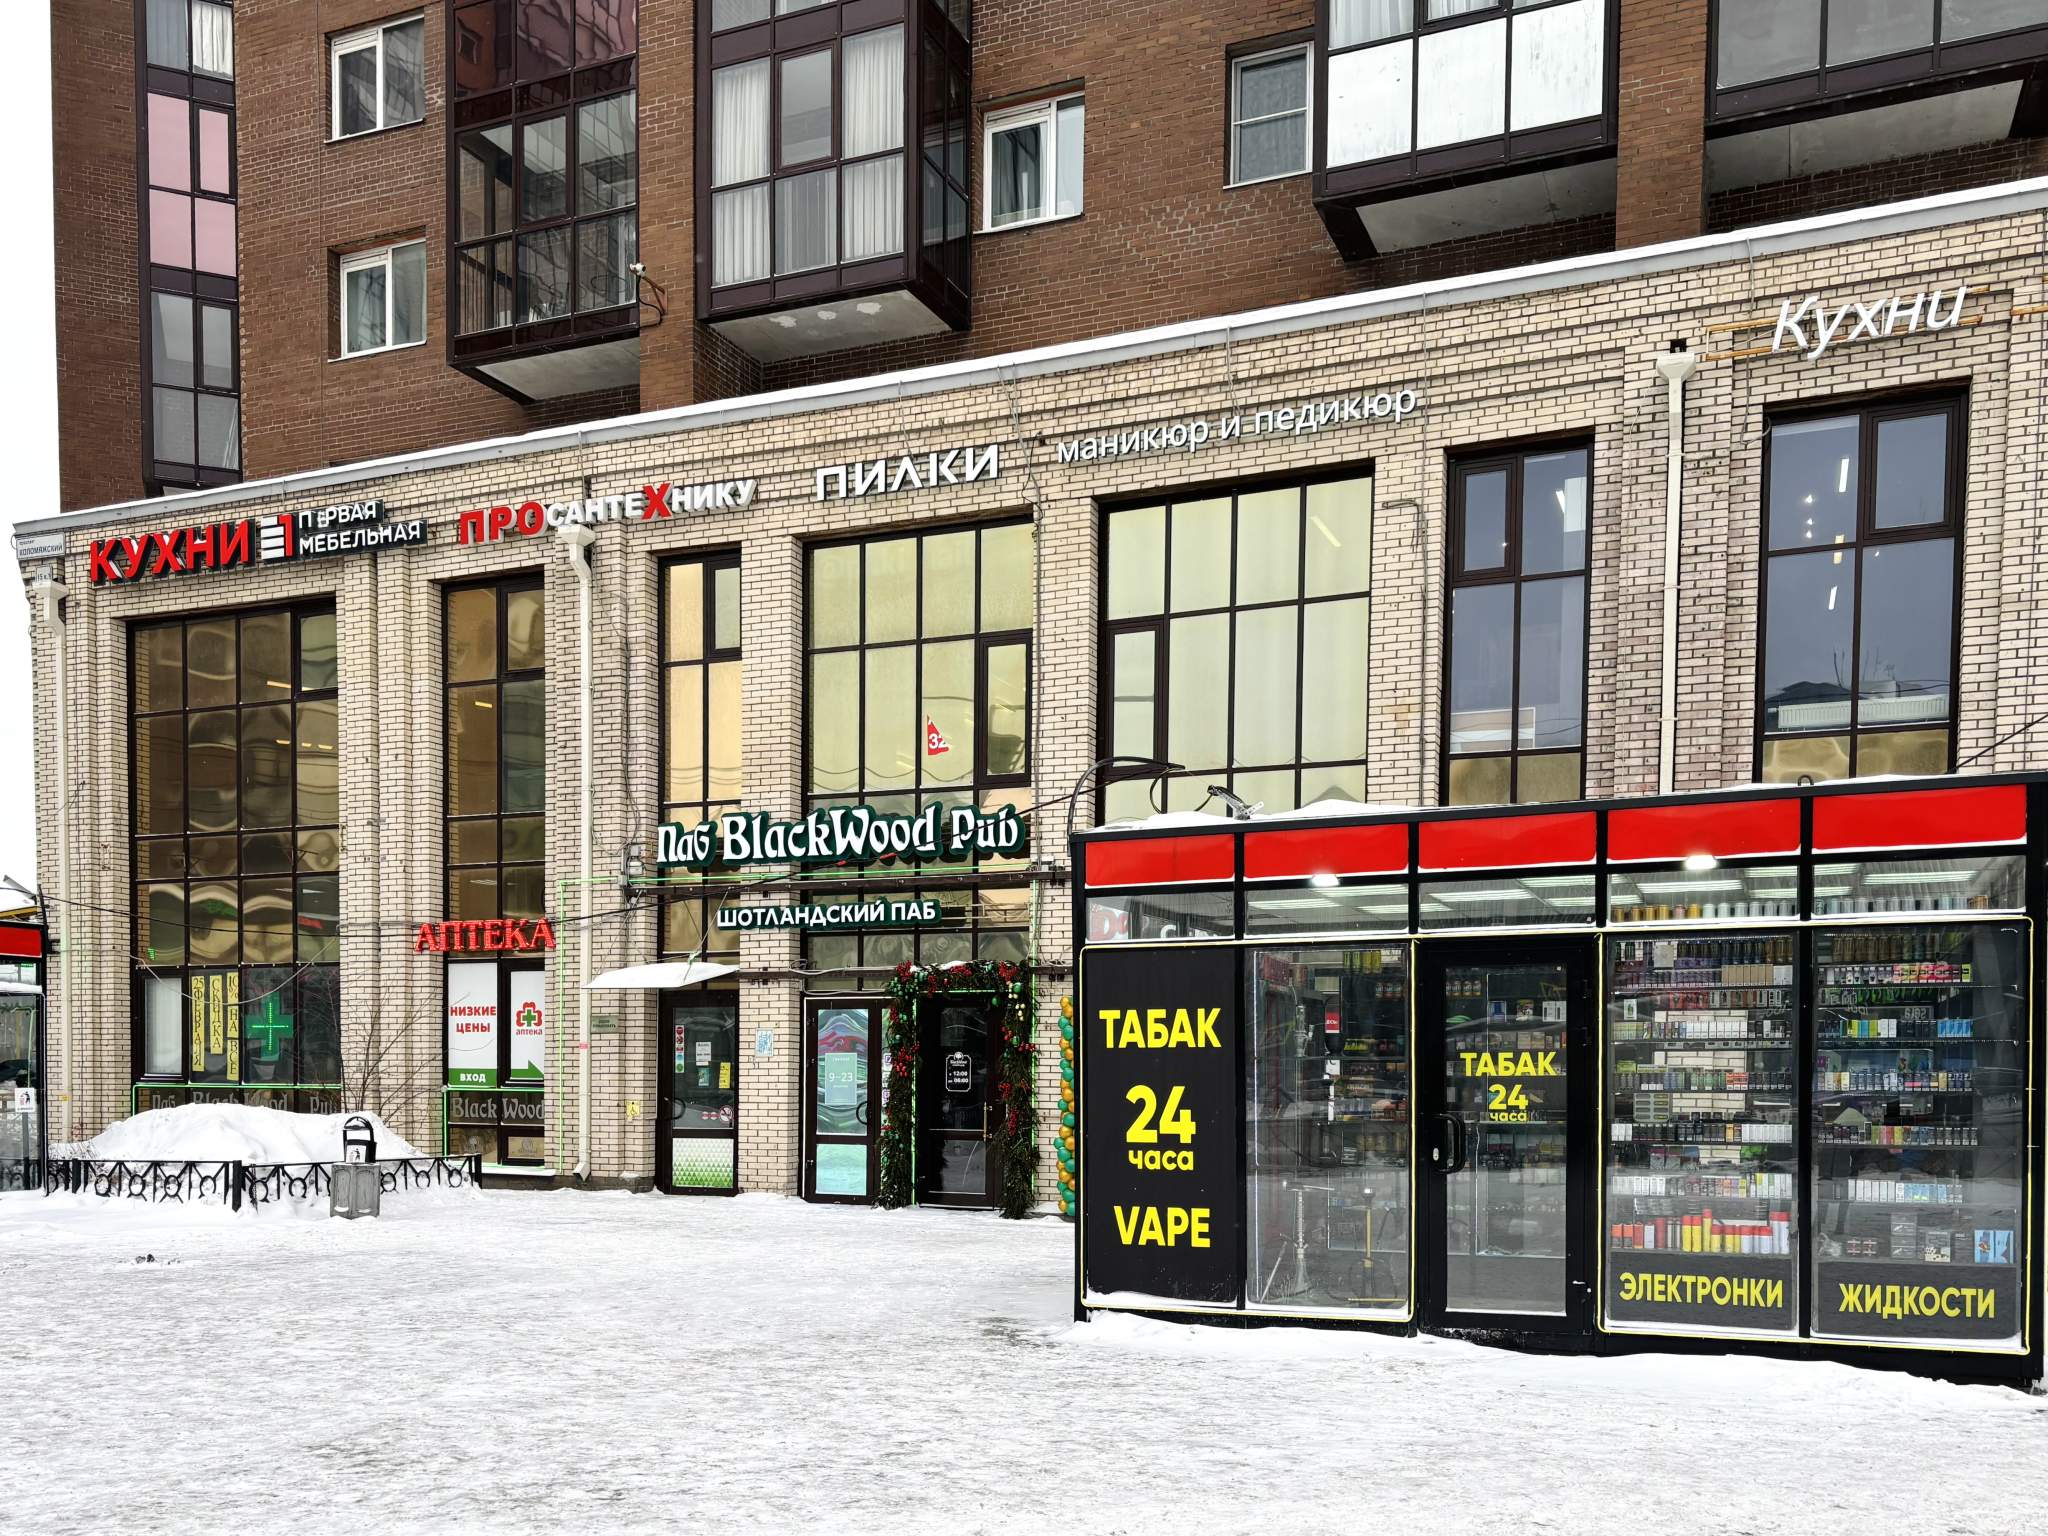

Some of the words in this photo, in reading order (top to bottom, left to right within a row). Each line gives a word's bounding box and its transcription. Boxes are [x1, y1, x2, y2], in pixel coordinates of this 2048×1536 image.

[1772, 286, 1967, 360] Кухни
[1057, 420, 1209, 464] маникюр
[1221, 416, 1240, 440] и
[1255, 388, 1416, 434] педикюр
[816, 443, 998, 501] ПИЛКИ
[90, 518, 252, 583] КУХНИ
[299, 520, 421, 555] МЕБЕЛЬНАЯ
[722, 805, 936, 861] BlackWood
[951, 808, 1022, 850] Pub
[717, 900, 884, 928] ШОТЛАНДСКИЙ
[891, 901, 936, 921] ПАБ
[415, 917, 557, 953] АПТЕКА
[450, 1006, 497, 1017] НИЗКИЕ
[456, 1022, 491, 1034] ЦЕНЫ
[1099, 1008, 1222, 1048] ТАБАК
[460, 1073, 486, 1082] ВХОД
[1459, 1051, 1558, 1077] ТАБАК
[451, 1097, 498, 1119] Black
[501, 1097, 545, 1120] Wood
[1125, 1085, 1196, 1143] 24
[1488, 1083, 1529, 1111] 24
[1489, 1111, 1528, 1122] часа
[1128, 1150, 1194, 1171] часа
[1113, 1206, 1211, 1248] VAPE
[1619, 1272, 1784, 1308] ЭЛЕКТРОНКИ
[1839, 1283, 1996, 1320] ЖИДКОСТИ
